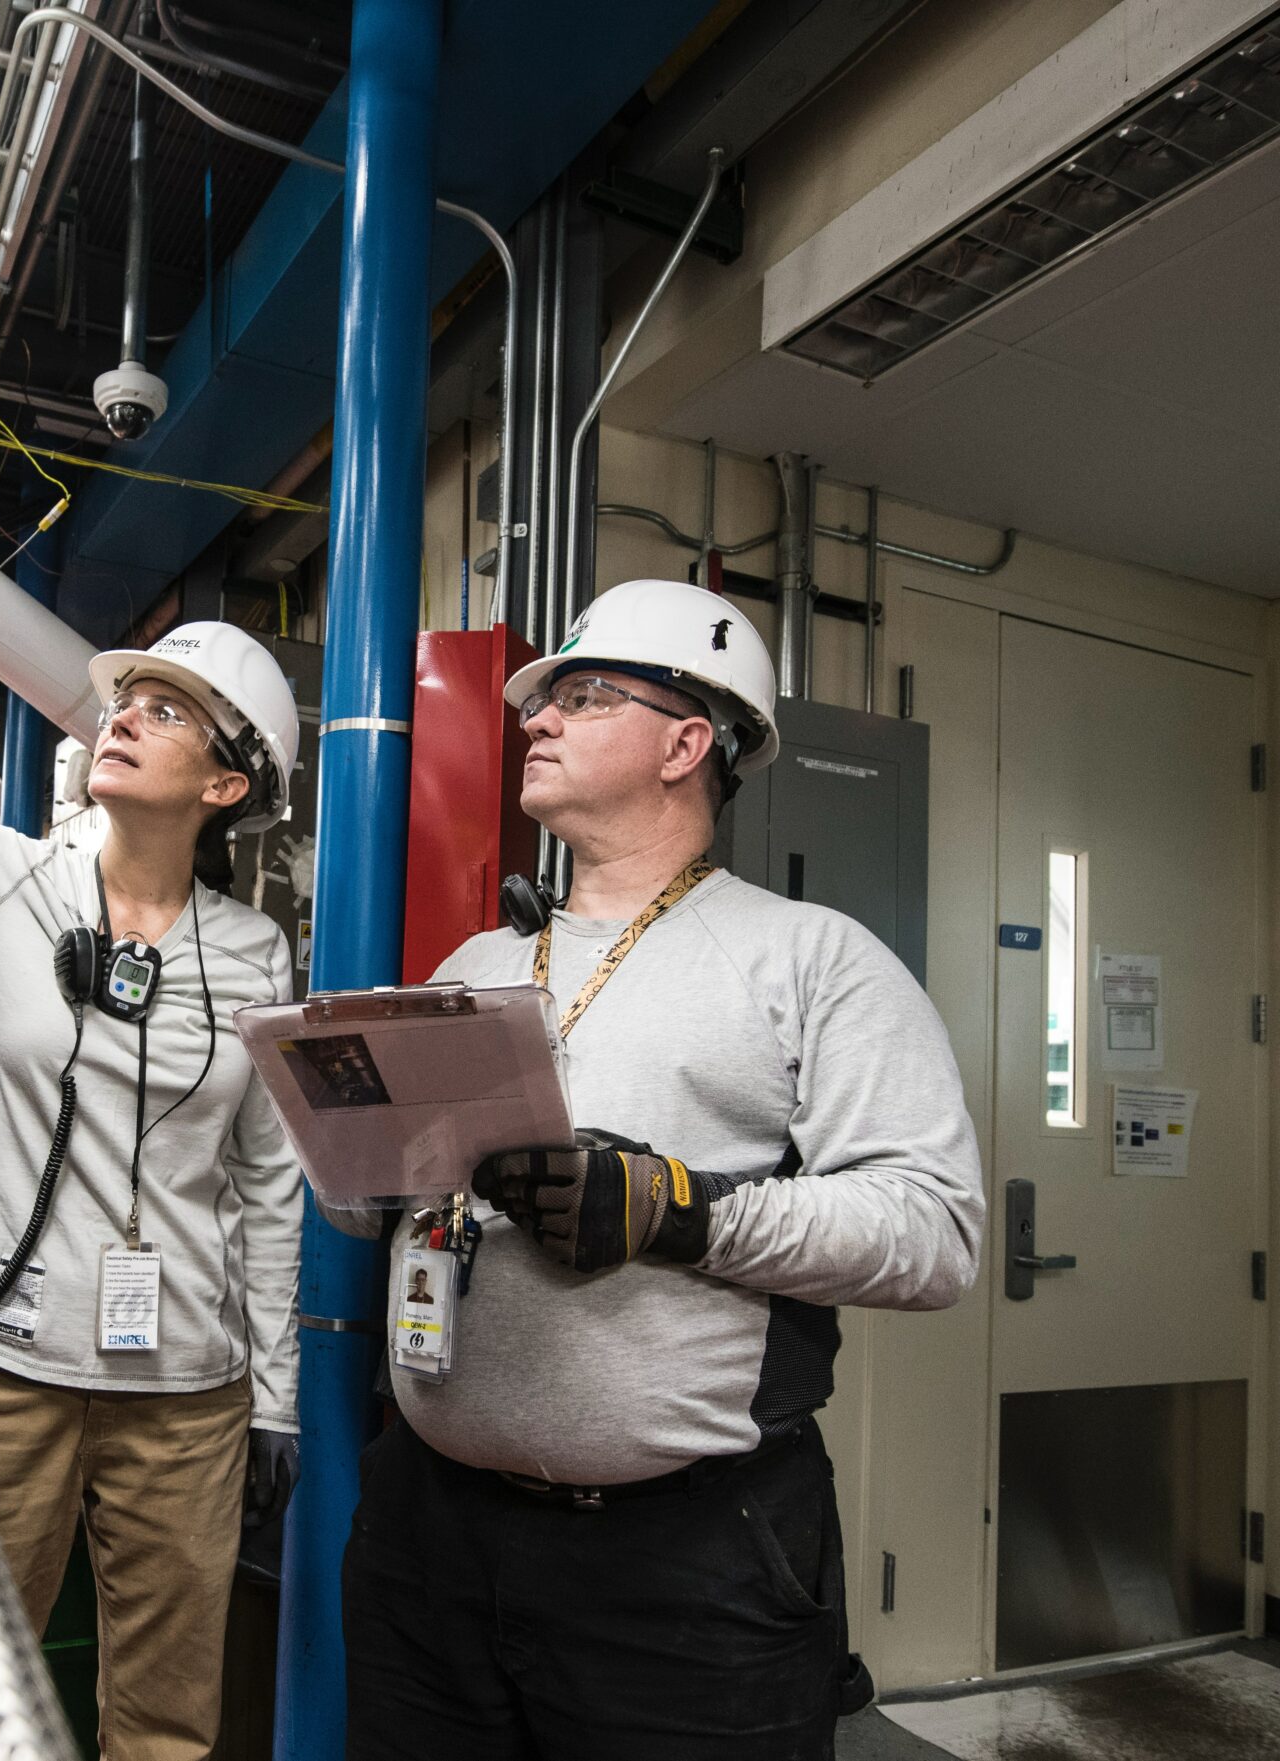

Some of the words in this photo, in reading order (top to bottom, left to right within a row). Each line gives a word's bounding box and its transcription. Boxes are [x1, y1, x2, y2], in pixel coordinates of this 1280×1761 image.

[168, 639, 201, 648] NREL
[1014, 932, 1029, 943] 127
[118, 1334, 150, 1345] NREL
